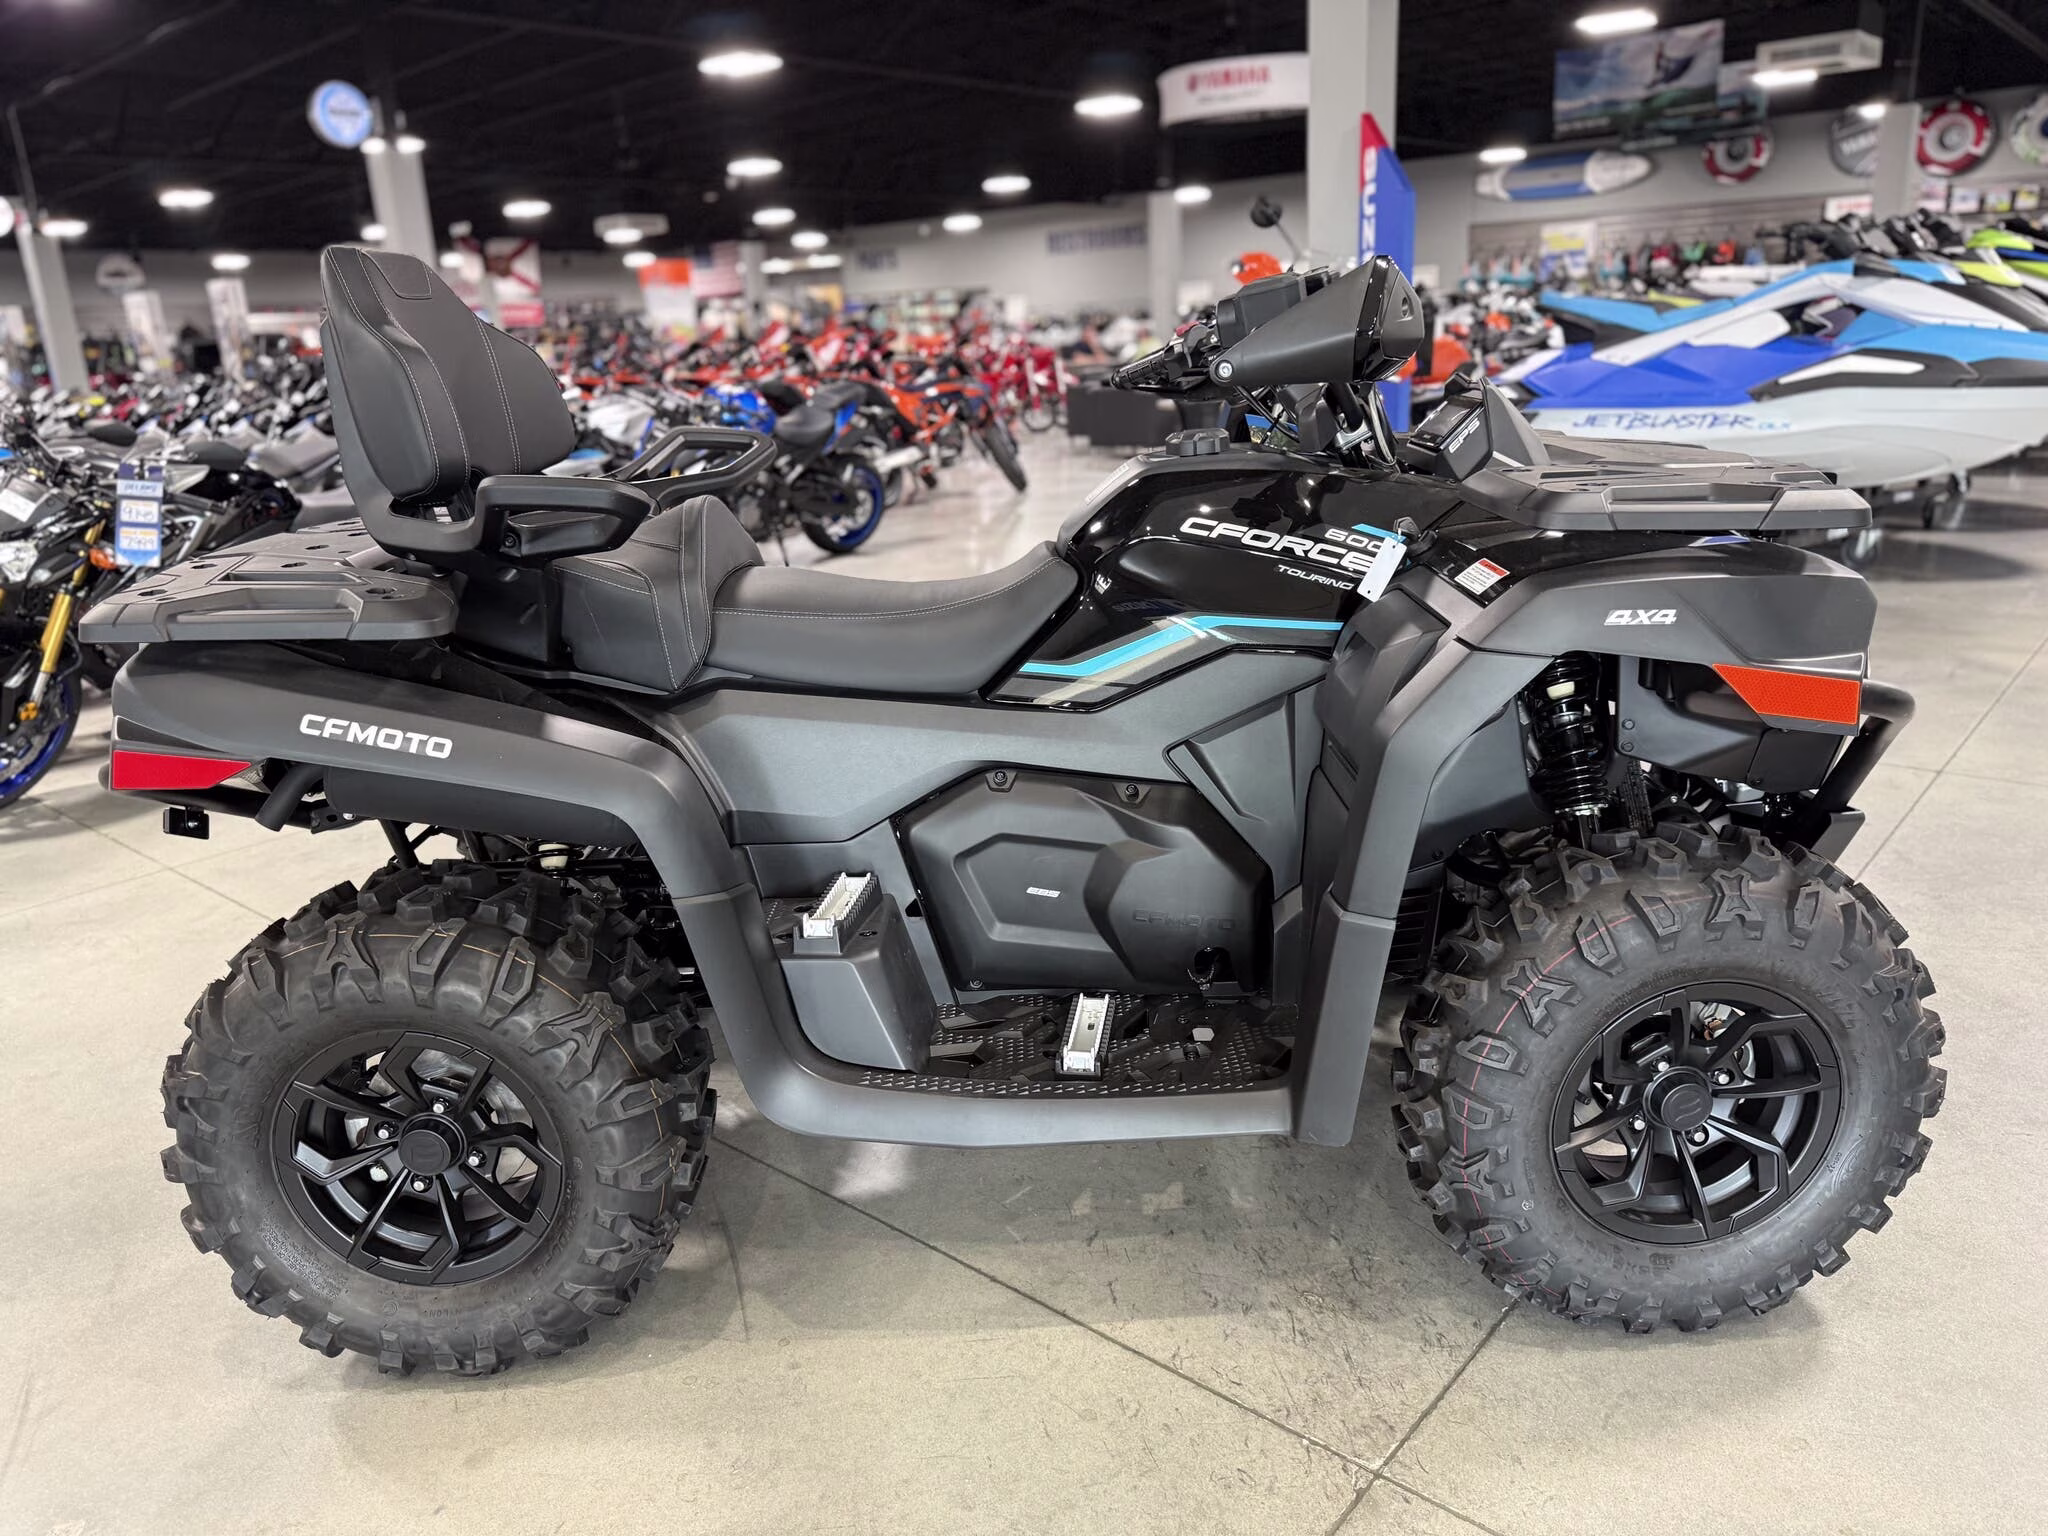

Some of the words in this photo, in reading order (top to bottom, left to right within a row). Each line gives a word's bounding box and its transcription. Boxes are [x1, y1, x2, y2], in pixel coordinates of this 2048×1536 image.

[1448, 417, 1480, 453] EPS
[1180, 517, 1375, 573] CFORCE
[1277, 564, 1354, 591] TOURING
[299, 713, 453, 759] CFMOTO
